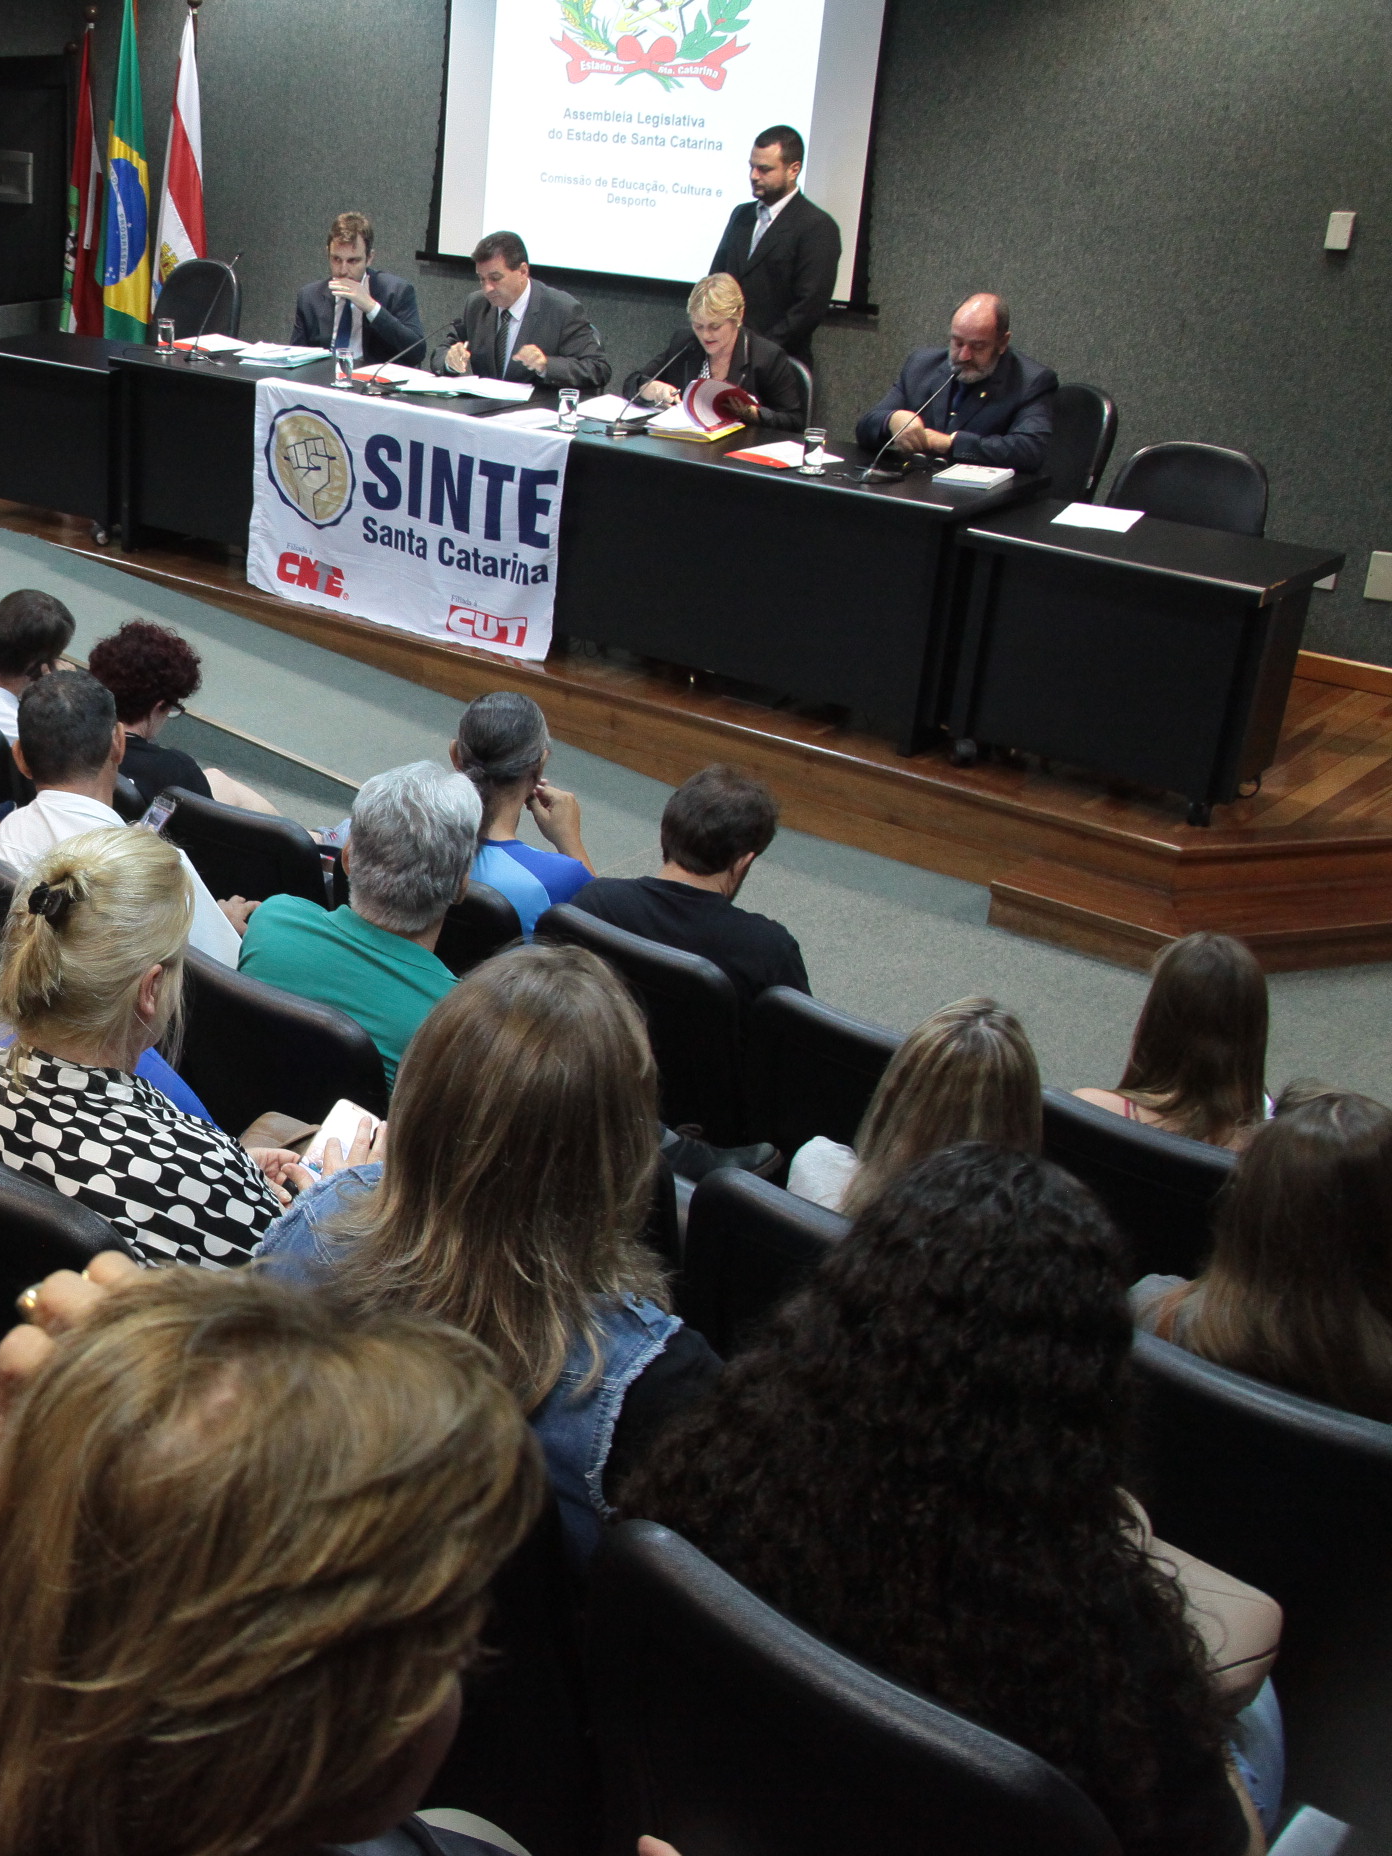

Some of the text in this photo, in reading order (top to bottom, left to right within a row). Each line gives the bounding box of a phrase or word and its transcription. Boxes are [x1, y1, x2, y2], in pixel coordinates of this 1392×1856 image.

[580, 60, 611, 72] Estado
[678, 66, 719, 79] Catarina
[563, 108, 705, 128] Assembleia Legislativa
[548, 128, 723, 151] do Estado de Santa Catarina
[540, 172, 723, 197] Comissão de Educação, Cultura e
[607, 193, 656, 207] Desporto
[363, 433, 558, 549] SINTE
[362, 516, 549, 586] Santa Catarina
[276, 552, 345, 598] CNTE
[448, 608, 526, 645] CUT
